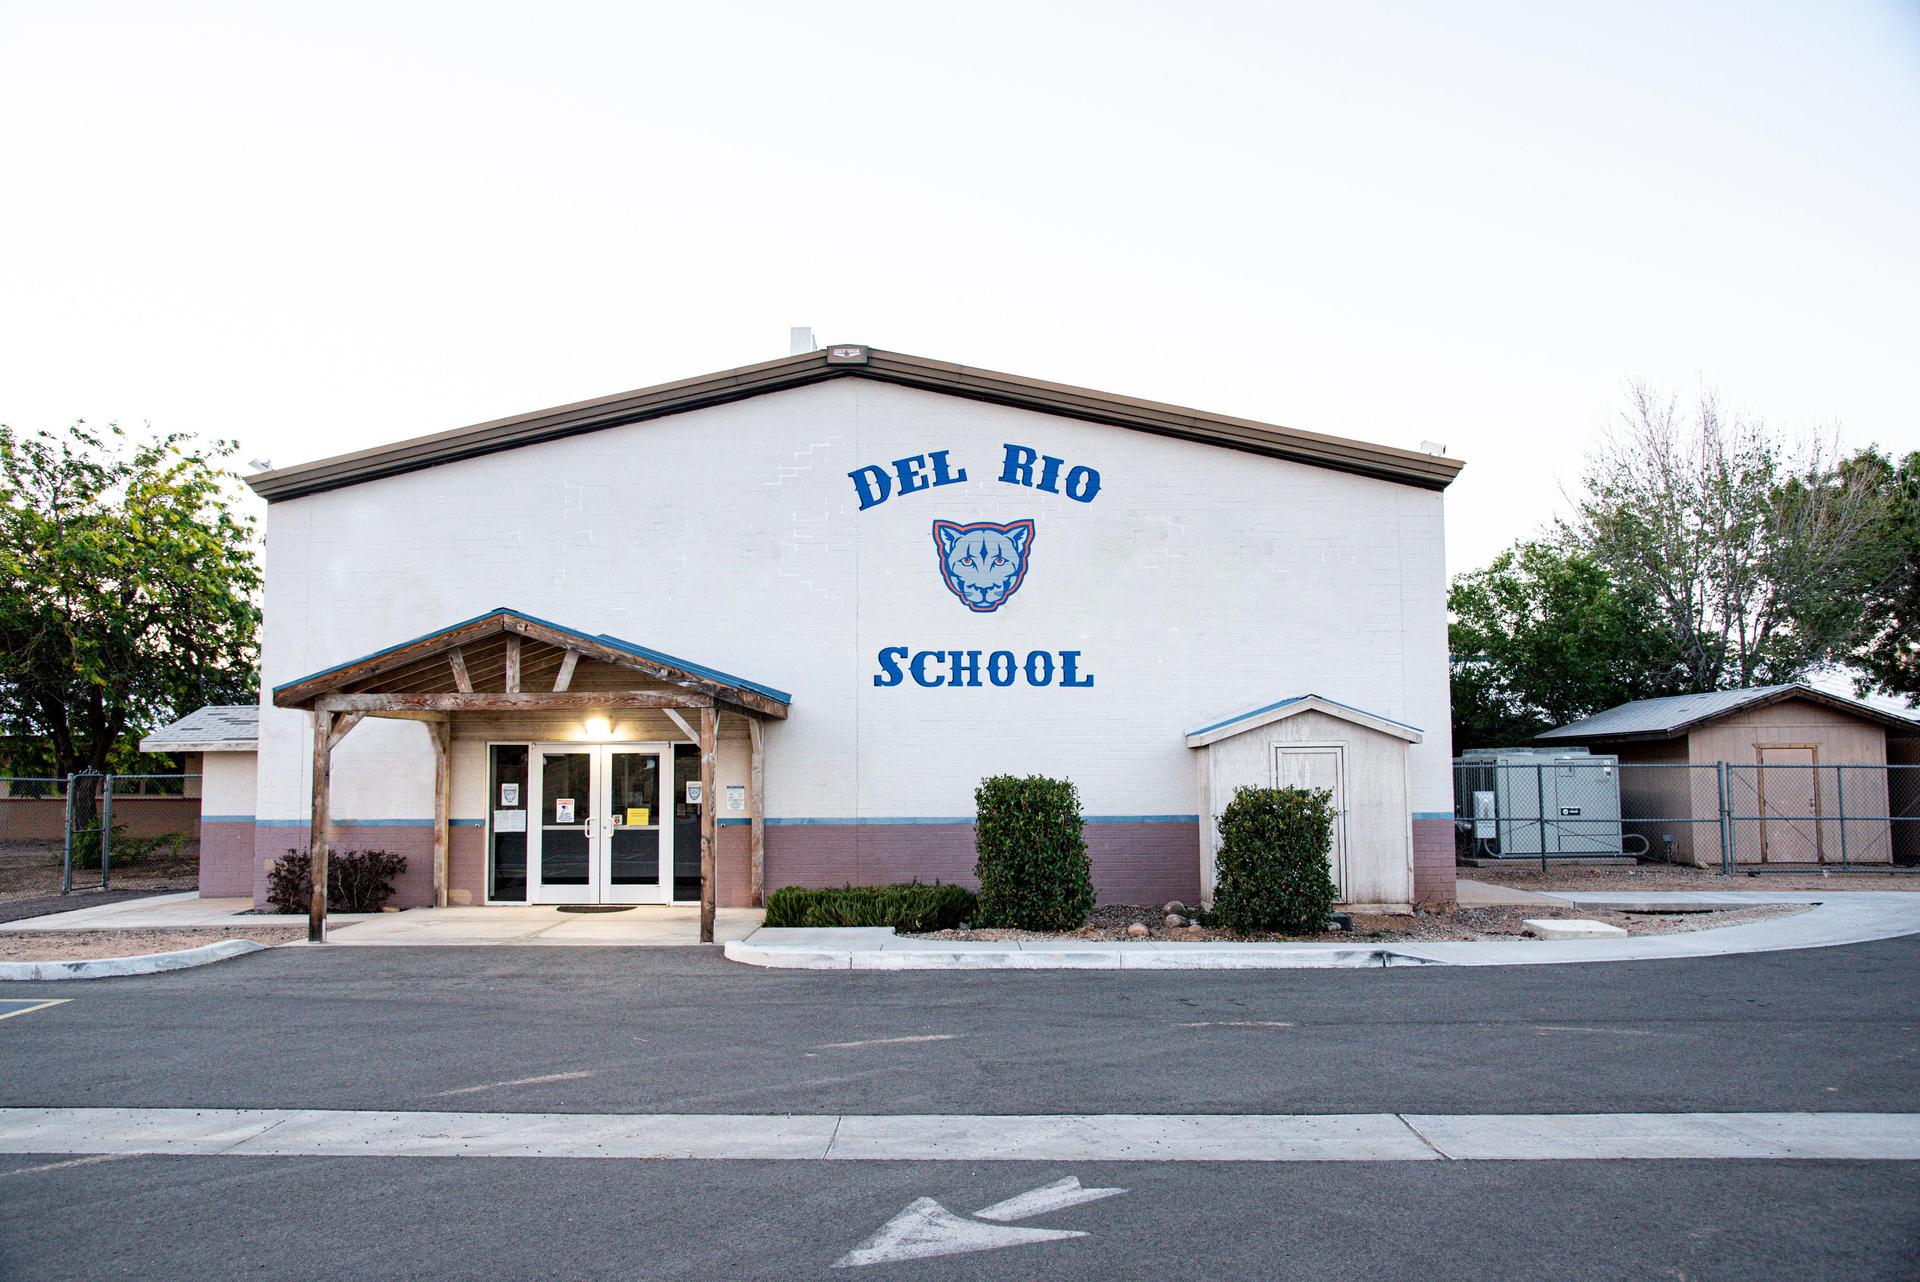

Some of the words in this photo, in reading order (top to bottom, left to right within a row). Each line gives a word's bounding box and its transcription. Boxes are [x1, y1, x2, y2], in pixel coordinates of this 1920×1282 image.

[848, 450, 967, 511] DEL
[998, 443, 1101, 503] RIO
[874, 646, 1094, 687] SCHOOL
